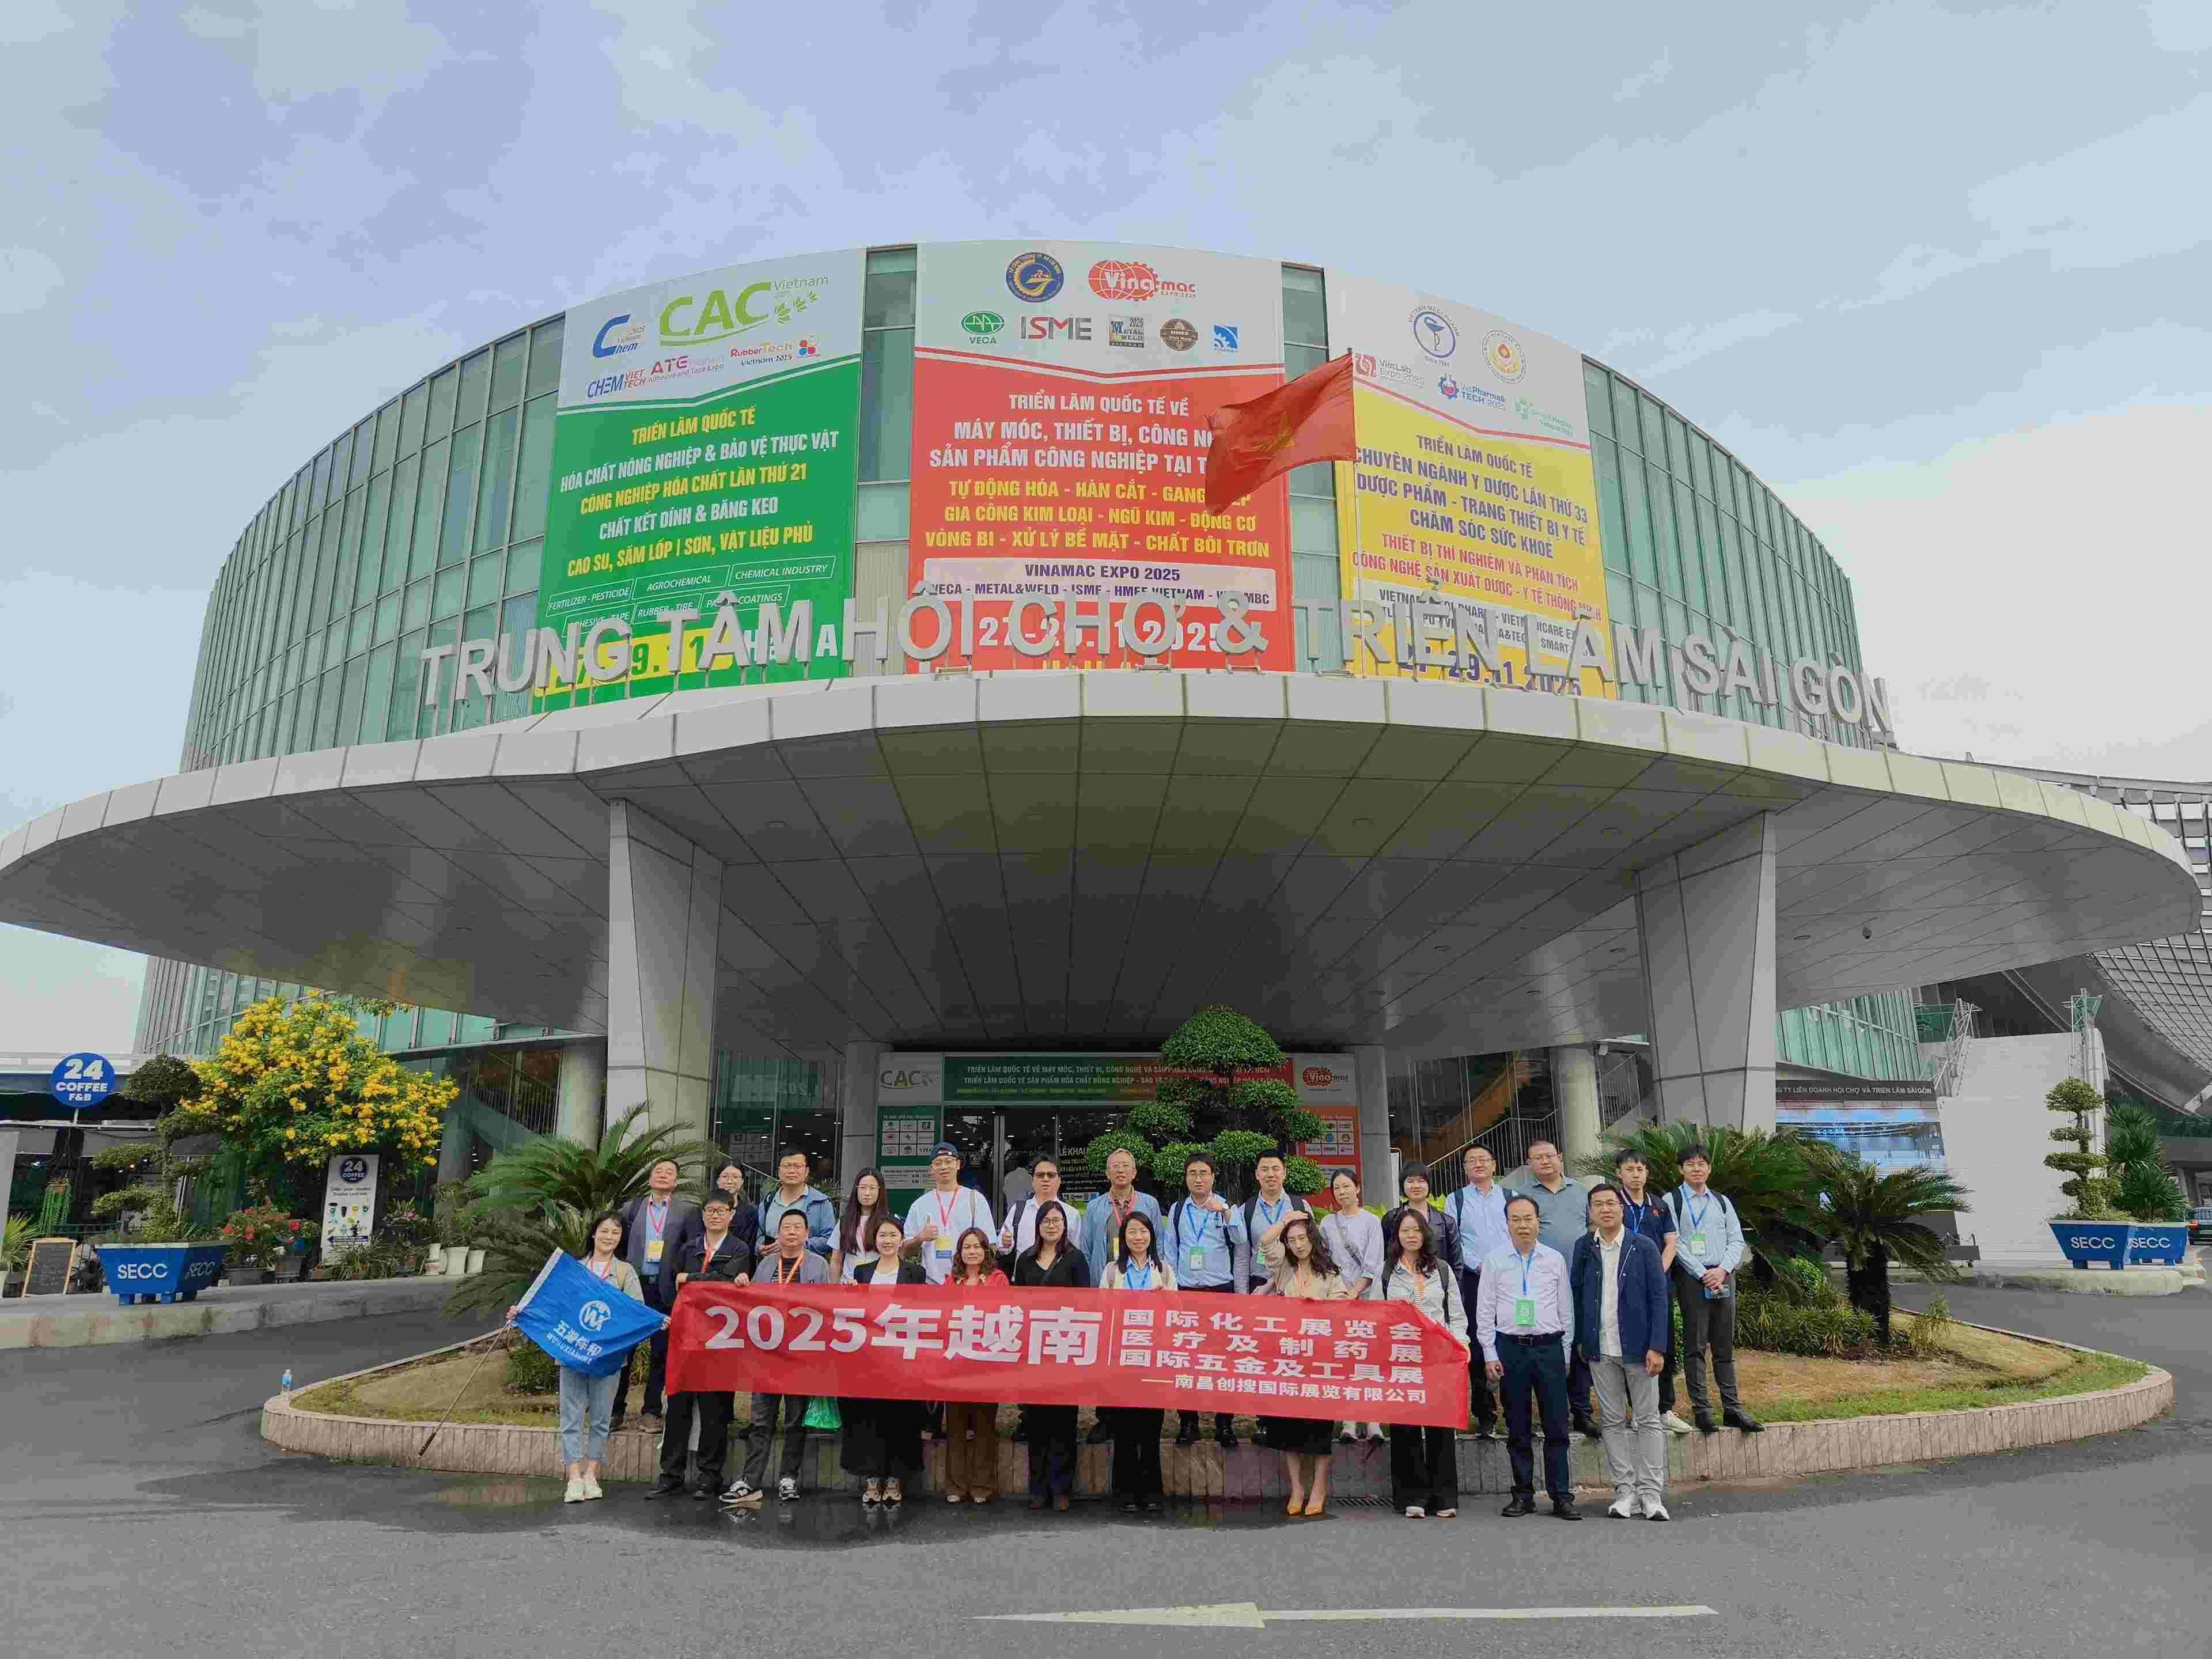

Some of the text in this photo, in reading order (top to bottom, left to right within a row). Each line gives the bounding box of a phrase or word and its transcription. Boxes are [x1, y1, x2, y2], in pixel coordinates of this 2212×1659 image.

[660, 276, 829, 336] CAC Vietnam
[1021, 317, 1092, 340] ISME
[1130, 317, 1143, 327] 2025
[651, 355, 691, 375] ATE
[1009, 388, 1055, 410] TRIỂN
[1100, 392, 1143, 414] QUỐC
[1147, 396, 1165, 415] TẾ
[1170, 394, 1188, 416] VỀ
[702, 405, 756, 431] QUỐC TẾ
[955, 419, 994, 440] MÁY
[1001, 420, 1047, 442] MÓC,
[1054, 416, 1105, 443] THIẾT
[1109, 425, 1133, 446] BỊ,
[1139, 423, 1187, 446] CÔNG
[1416, 434, 1453, 454] TRIỂN
[560, 474, 582, 492] HÓA
[618, 457, 652, 478] NÔNG
[655, 448, 701, 470] NGHIỆP
[770, 434, 807, 453] THỰC
[811, 430, 839, 450] VẬT
[930, 444, 968, 467] SẢN
[974, 443, 1028, 467] PHẨM
[1034, 445, 1085, 468] CÔNG
[1092, 448, 1158, 475] NGHIỆP
[1164, 454, 1192, 475] TẠI
[580, 463, 807, 514] CÔNG NGHIỆP HÓA CHẤT 21
[949, 478, 1205, 503] TỰ ĐỘNG HÓA HÀN GANG
[1417, 461, 1587, 523] NGÀNH Y DƯỢC 33
[944, 506, 972, 521] GIA
[976, 502, 1019, 522] CÔNG
[1024, 506, 1054, 521] KIM
[1059, 506, 1092, 526] LOẠI
[1146, 509, 1175, 526] KIM
[1190, 510, 1232, 532] ĐỘNG
[1236, 515, 1257, 531] CƠ
[1357, 472, 1569, 539] DƯỢC PHẨM TRANG THIẾT Y
[599, 497, 778, 540] CHẤT KẾT DÍNH KEO
[1459, 518, 1486, 541] SÓC
[567, 557, 590, 577] CAO
[593, 554, 613, 573] SU,
[648, 538, 673, 562] LỐP
[719, 529, 746, 551] VẬT
[749, 526, 779, 549] LIỆU
[783, 520, 813, 544] PHỦ
[925, 528, 972, 547] VÒNG
[977, 531, 994, 547] BI
[1040, 527, 1059, 548] LÝ
[1194, 535, 1221, 554] BÔI
[1227, 540, 1269, 558] TRƠN
[1382, 533, 1416, 552] THIẾT
[1421, 543, 1432, 556] BỊ
[646, 575, 711, 592] AGROCHEMICAL
[735, 563, 828, 581] CHEMICAL INDUSTRY
[1025, 563, 1180, 581] VINAMAC EXPO 2025
[1390, 556, 1421, 576] NGHỆ
[1522, 586, 1527, 600] Y
[548, 587, 629, 609] FERTILIZER PESTICIDE
[738, 593, 783, 604] COATINGS
[421, 618, 632, 704] TRUNG
[657, 590, 812, 672] TÂM
[843, 580, 974, 672] HỘI
[1008, 588, 1187, 668] CHỢ
[1216, 590, 1268, 656] &
[1291, 577, 1500, 673] TRIỂN
[1524, 608, 1665, 690] LÃM
[1682, 626, 1776, 706] SÀI
[1790, 651, 1893, 733] GÒN
[1541, 638, 1569, 653] SMART
[63, 1058, 103, 1080] 24
[880, 1070, 922, 1087] CAC
[56, 1082, 108, 1093] COFFEE
[69, 1093, 92, 1102] F&B
[344, 1161, 363, 1172] 24
[2071, 1236, 2116, 1249] SECC
[2130, 1236, 2171, 1249] SECC
[118, 1263, 168, 1279] SECC
[185, 1261, 215, 1278] SECC
[704, 1302, 1102, 1366] 2025年越南
[1122, 1309, 1423, 1341] 国际化工展览会
[1121, 1330, 1423, 1363] 医疗及制药展
[1119, 1350, 1425, 1384] 国际五金及工具展
